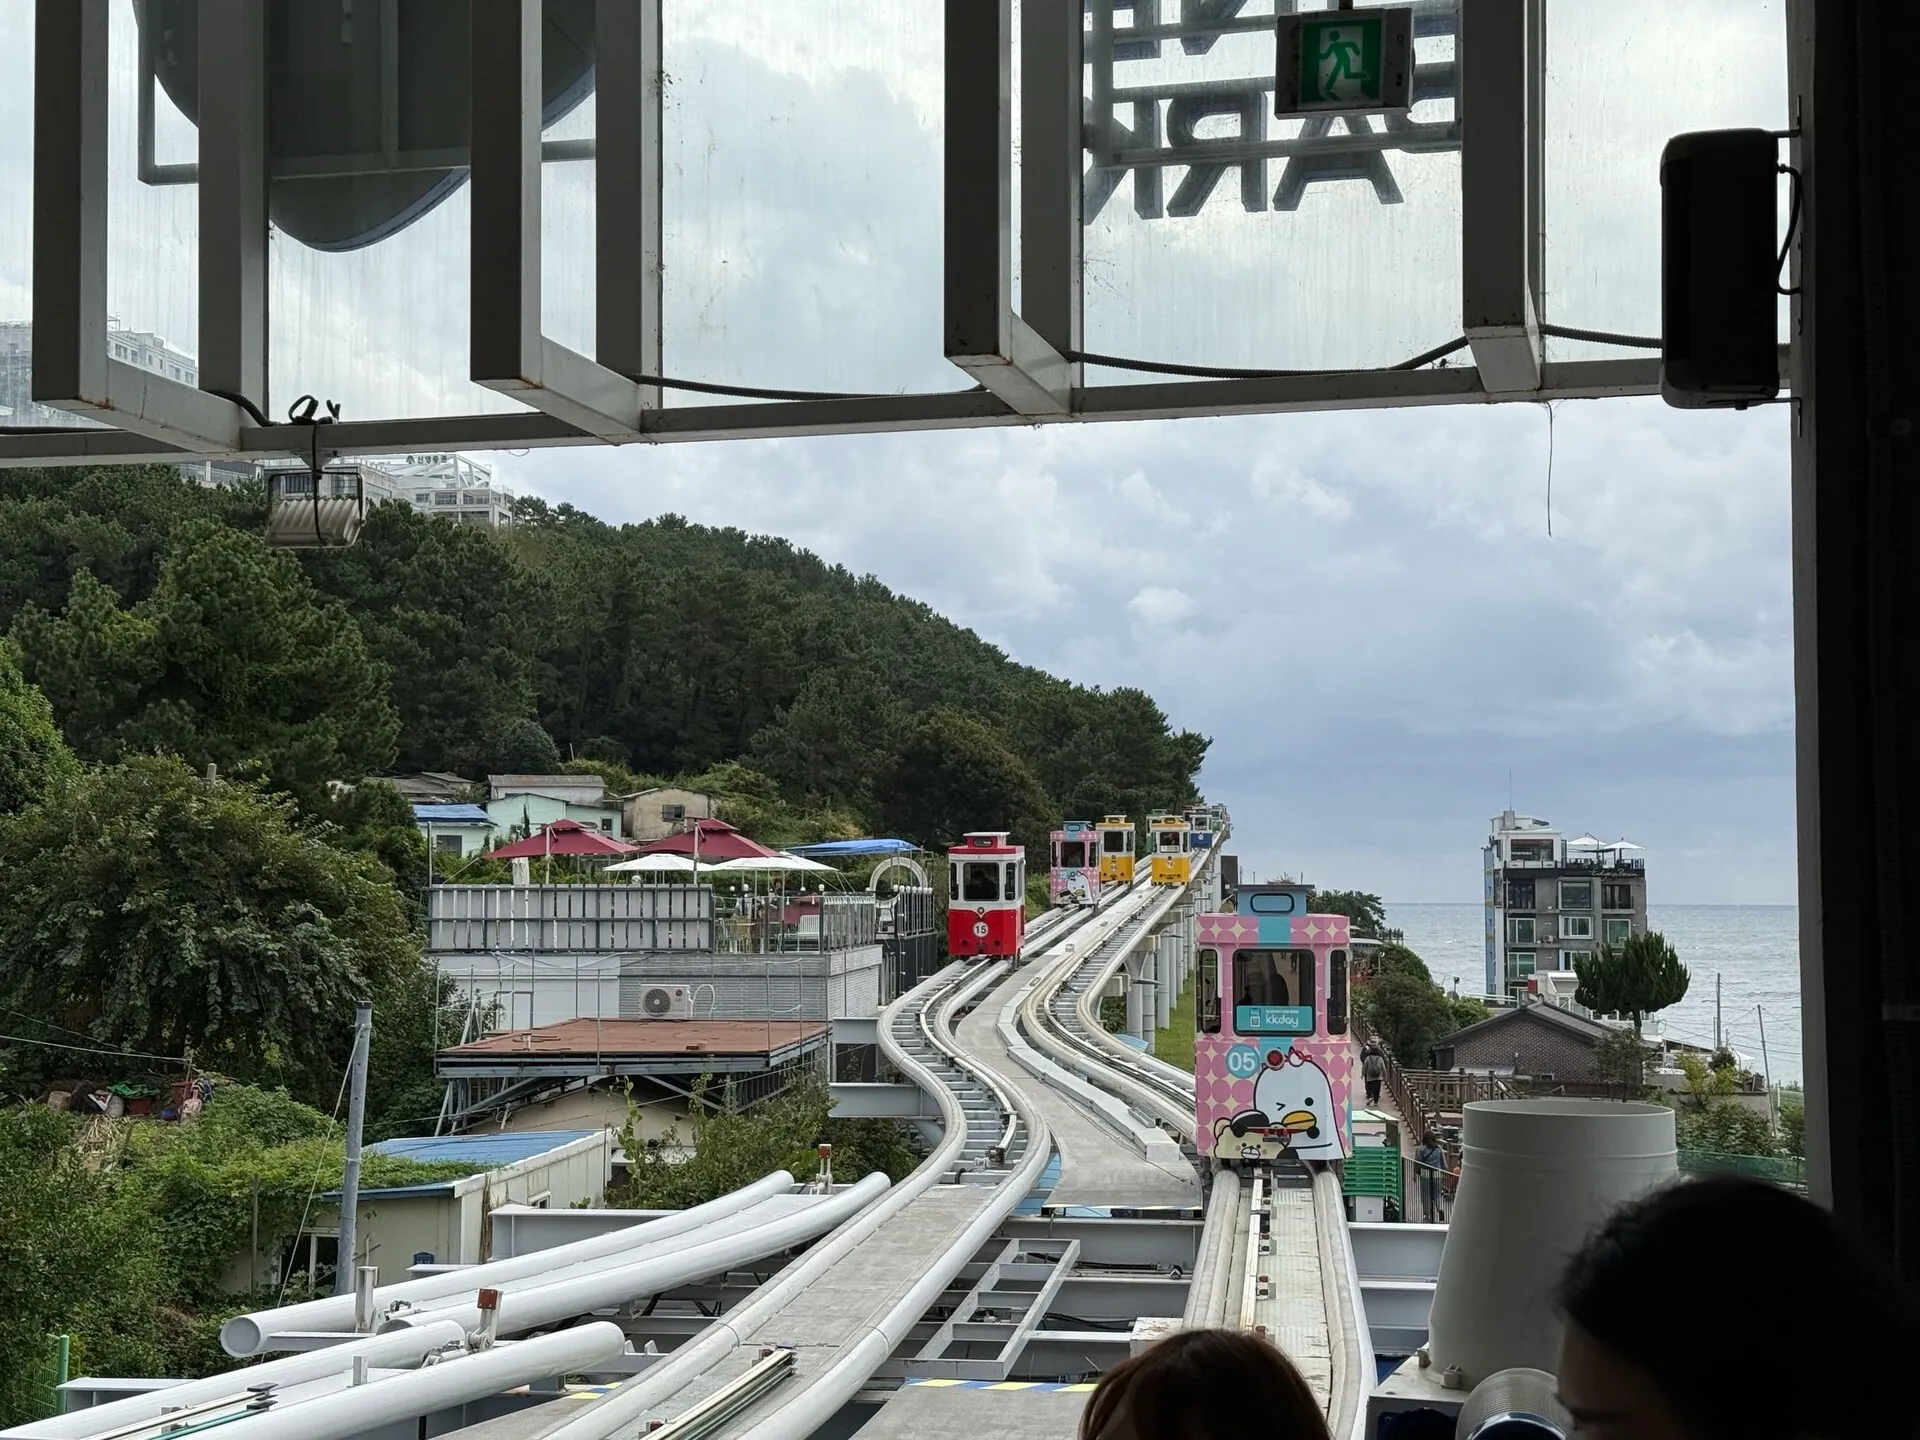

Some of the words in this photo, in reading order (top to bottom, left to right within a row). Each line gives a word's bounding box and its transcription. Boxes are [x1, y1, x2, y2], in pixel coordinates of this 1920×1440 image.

[975, 925, 986, 934] 15
[1265, 1014, 1299, 1028] kkday
[1228, 1051, 1256, 1072] 05
